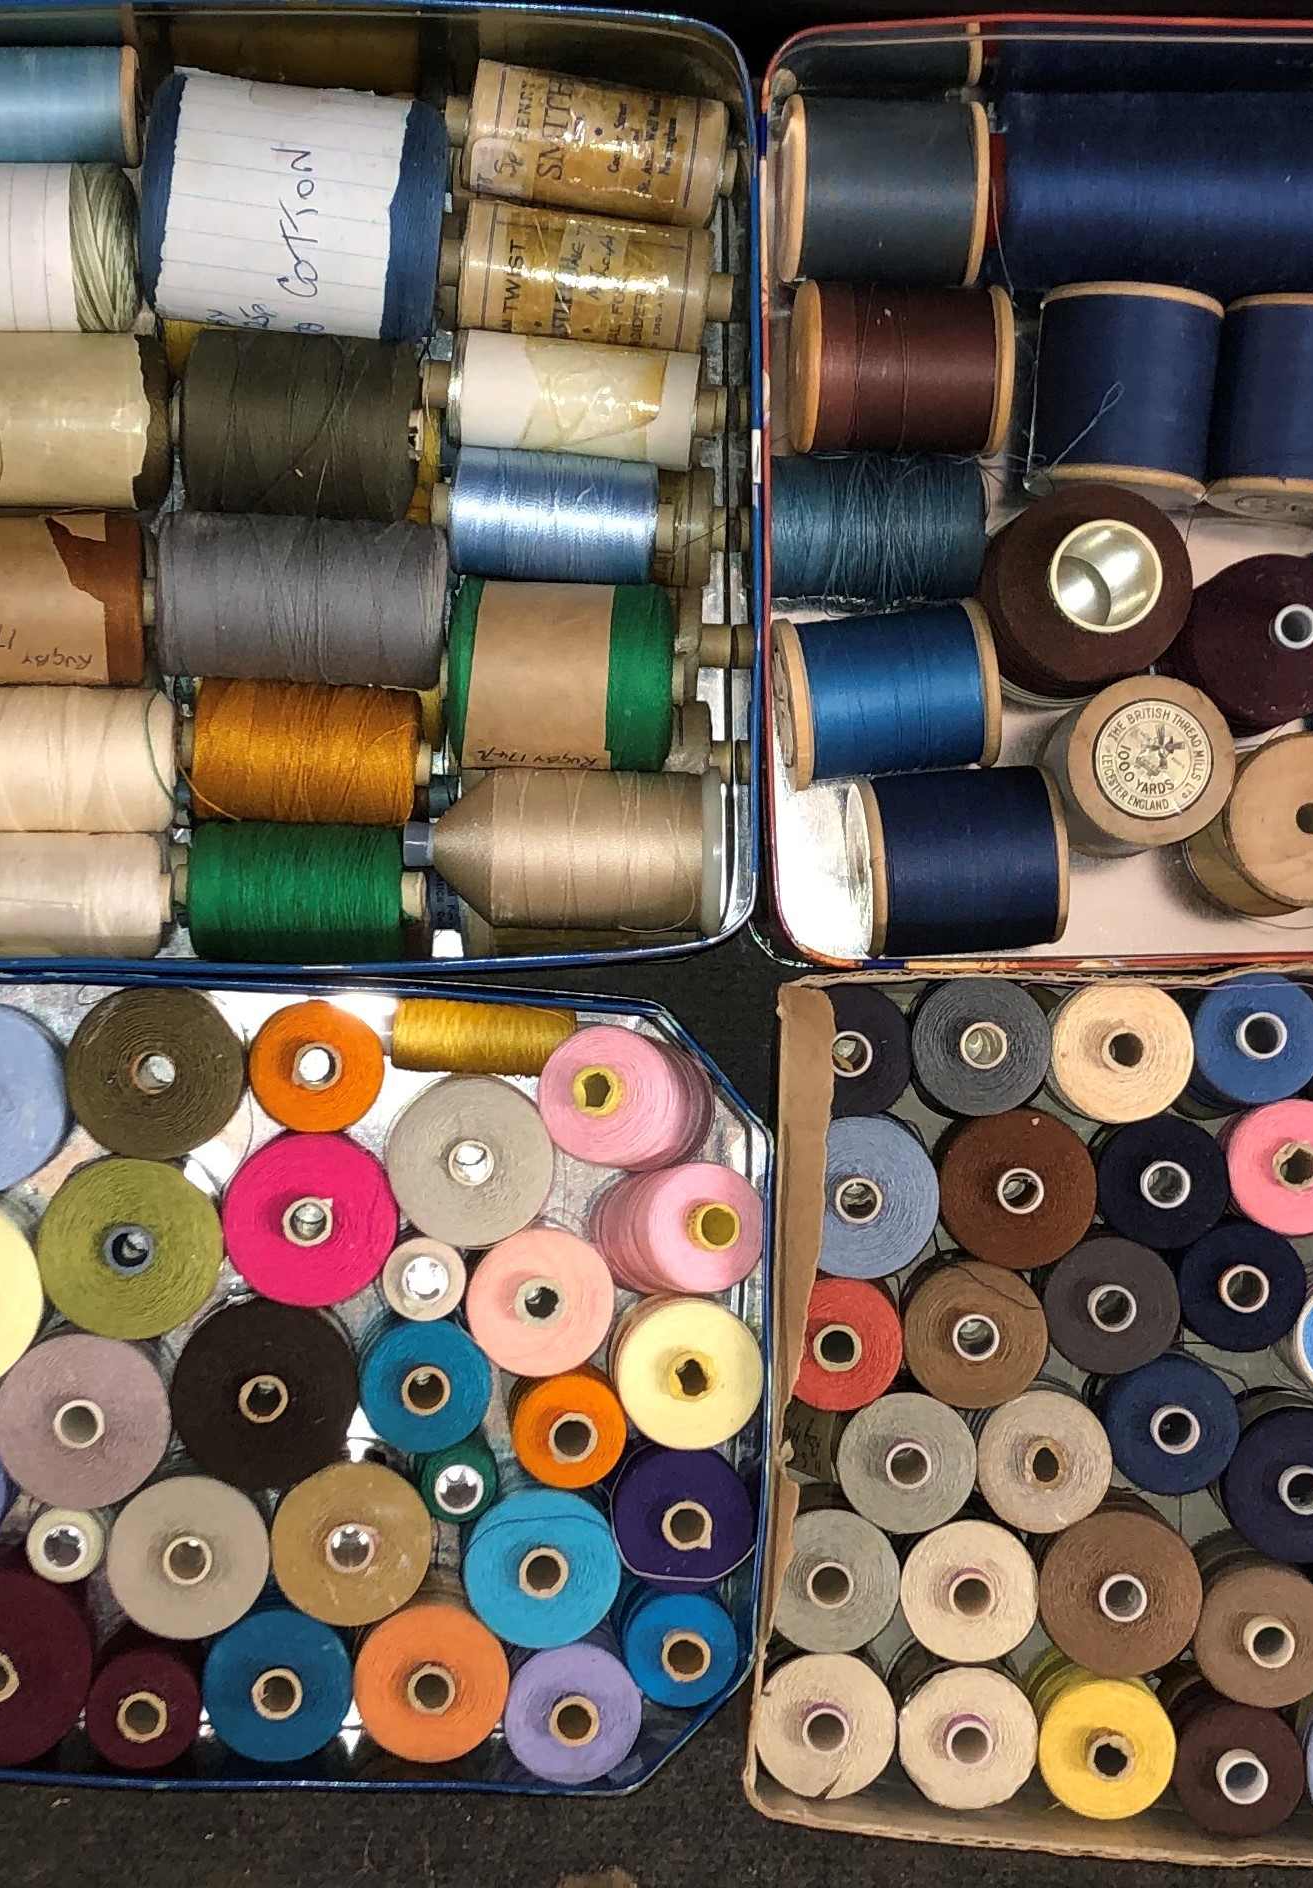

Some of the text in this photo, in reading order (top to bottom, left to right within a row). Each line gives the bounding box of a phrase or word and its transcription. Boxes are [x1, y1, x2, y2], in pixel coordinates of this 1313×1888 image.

[1108, 720, 1127, 742] THE
[1125, 707, 1171, 725] BRITISH
[1171, 712, 1202, 748] THREAD
[1190, 749, 1205, 781] MILLS
[1117, 744, 1174, 795] 1000 YARDS
[1102, 754, 1170, 811] LEICESTER ENGLAND
